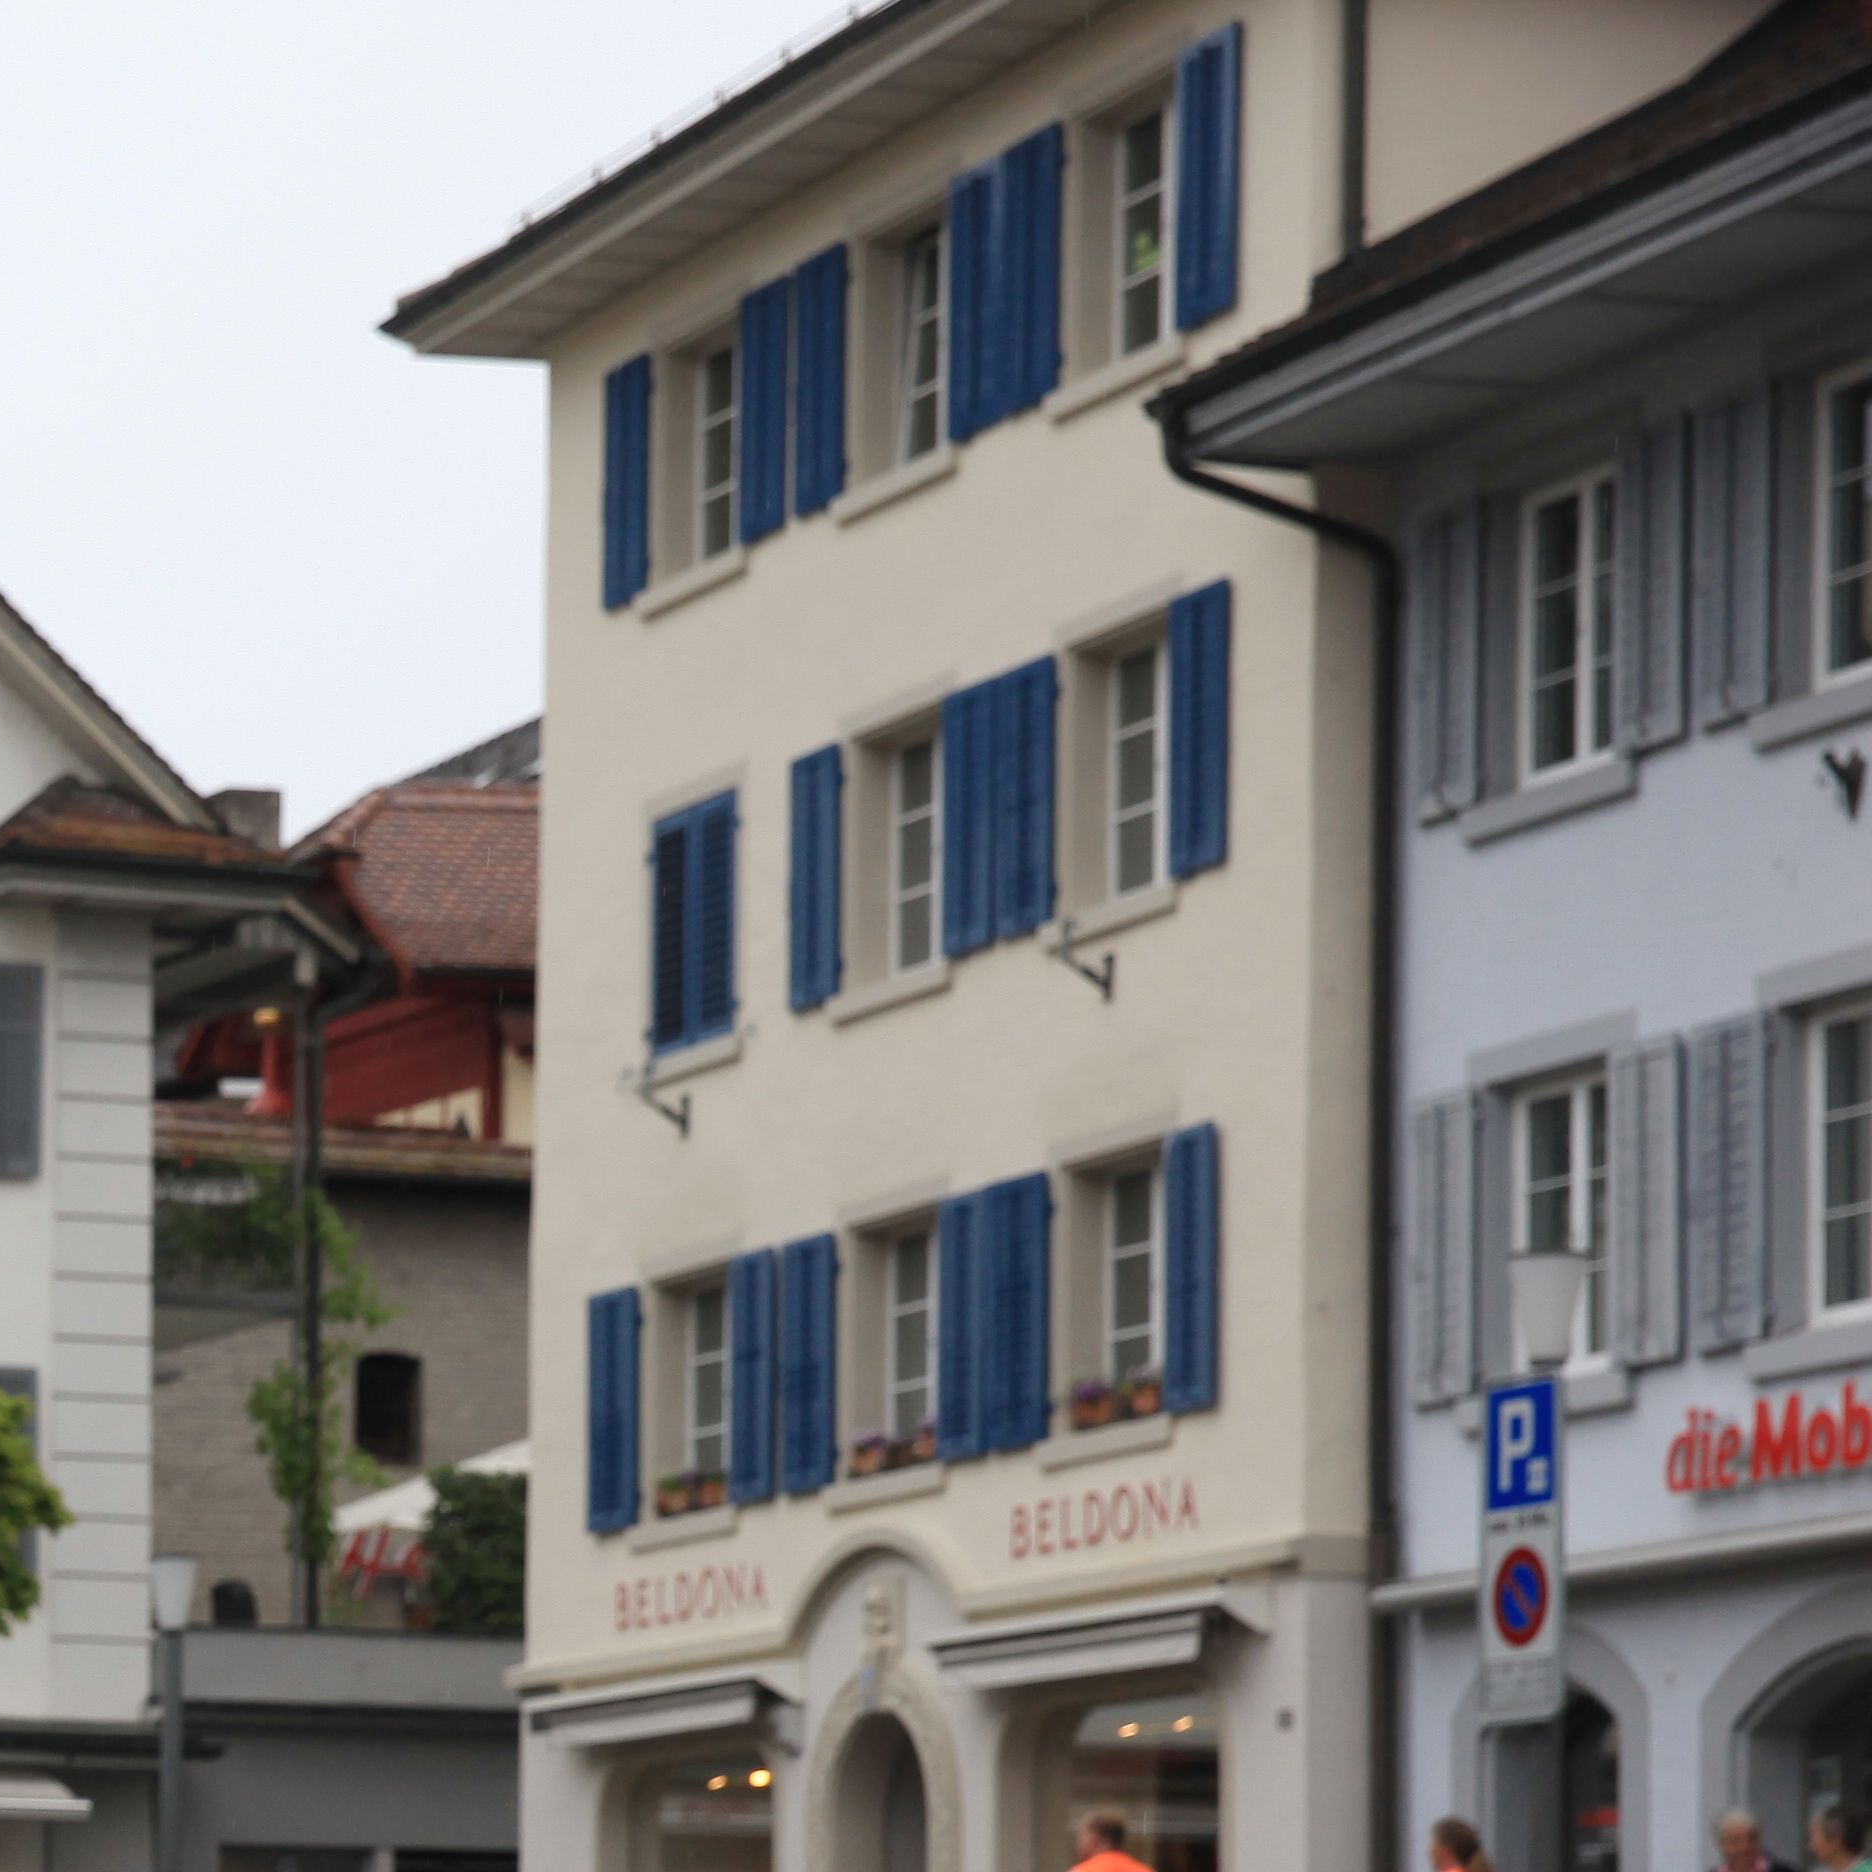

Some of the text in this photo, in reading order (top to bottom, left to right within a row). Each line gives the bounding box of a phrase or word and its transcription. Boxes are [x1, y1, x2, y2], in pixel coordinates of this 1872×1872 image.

[1497, 1398, 1536, 1493] P
[1010, 1480, 1201, 1560] BELDONA
[613, 1561, 768, 1633] BELDONA
